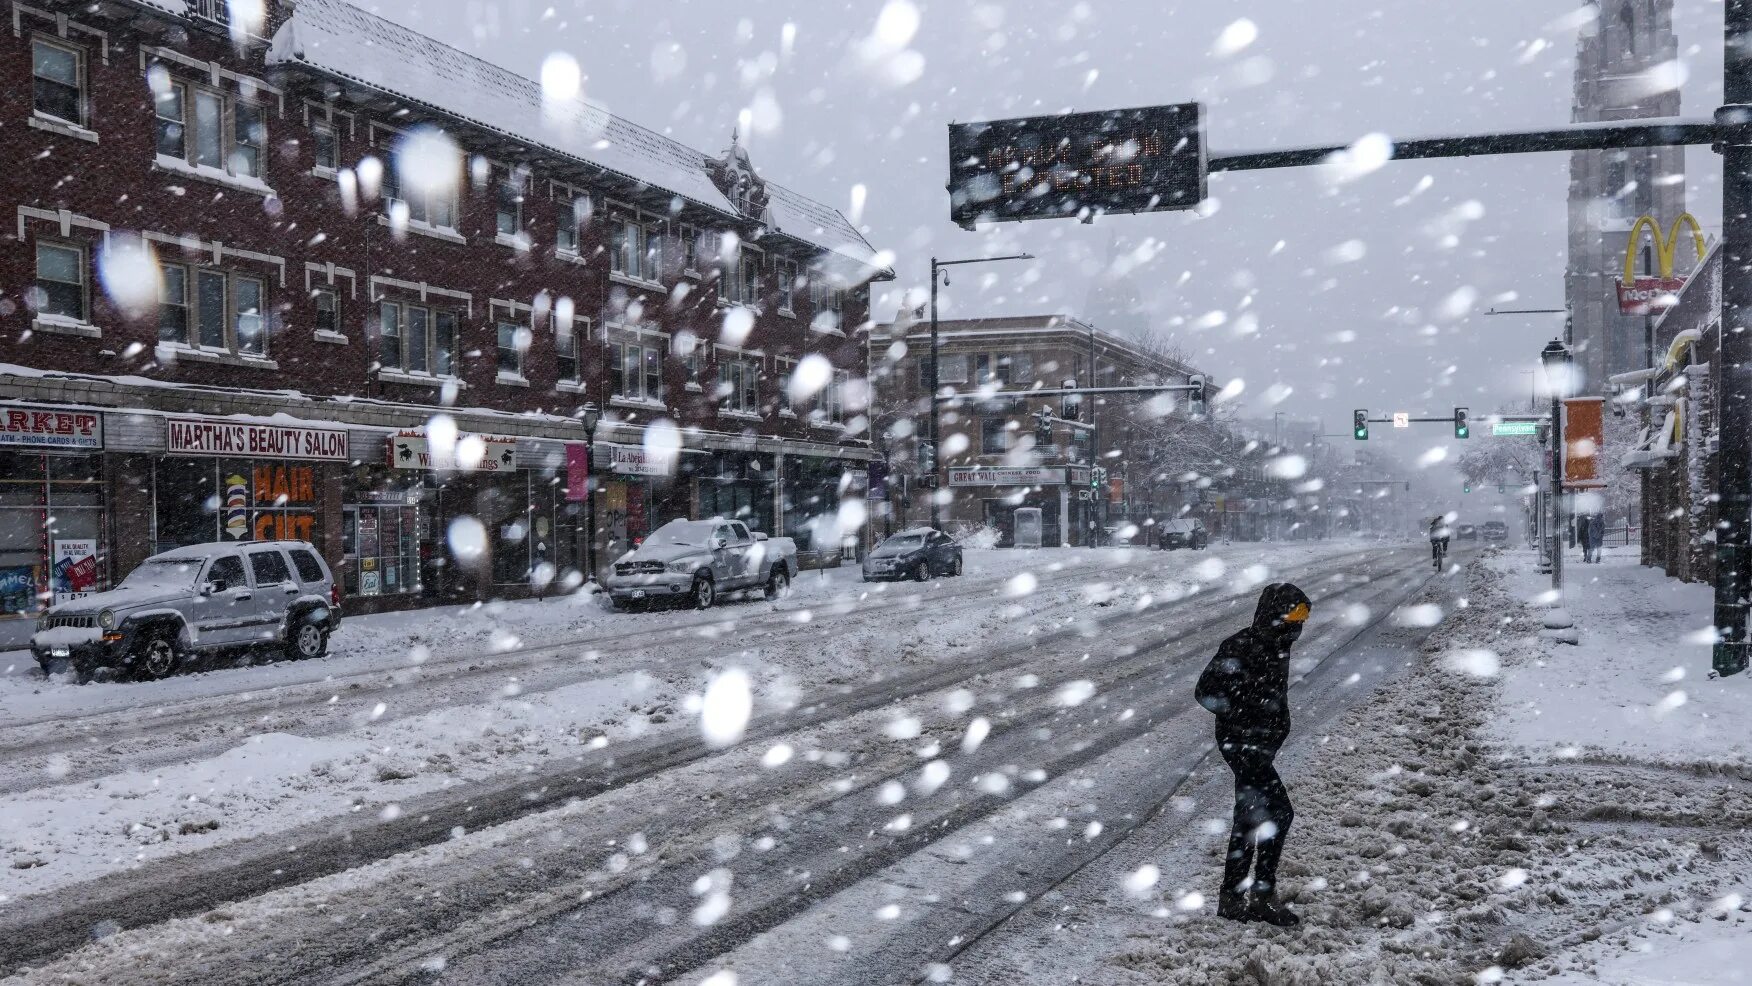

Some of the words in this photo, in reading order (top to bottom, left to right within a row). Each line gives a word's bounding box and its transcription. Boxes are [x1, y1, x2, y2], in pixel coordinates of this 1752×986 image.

[1005, 165, 1142, 193] EXPECTED
[48, 437, 70, 445] CARDS
[78, 438, 97, 446] GIFTS
[170, 423, 245, 452] MARTHA'S
[249, 428, 302, 454] BEAUTY
[305, 431, 345, 457] SALON
[255, 465, 315, 502] HAIR
[954, 472, 976, 482] GREAT
[978, 472, 996, 481] WALL
